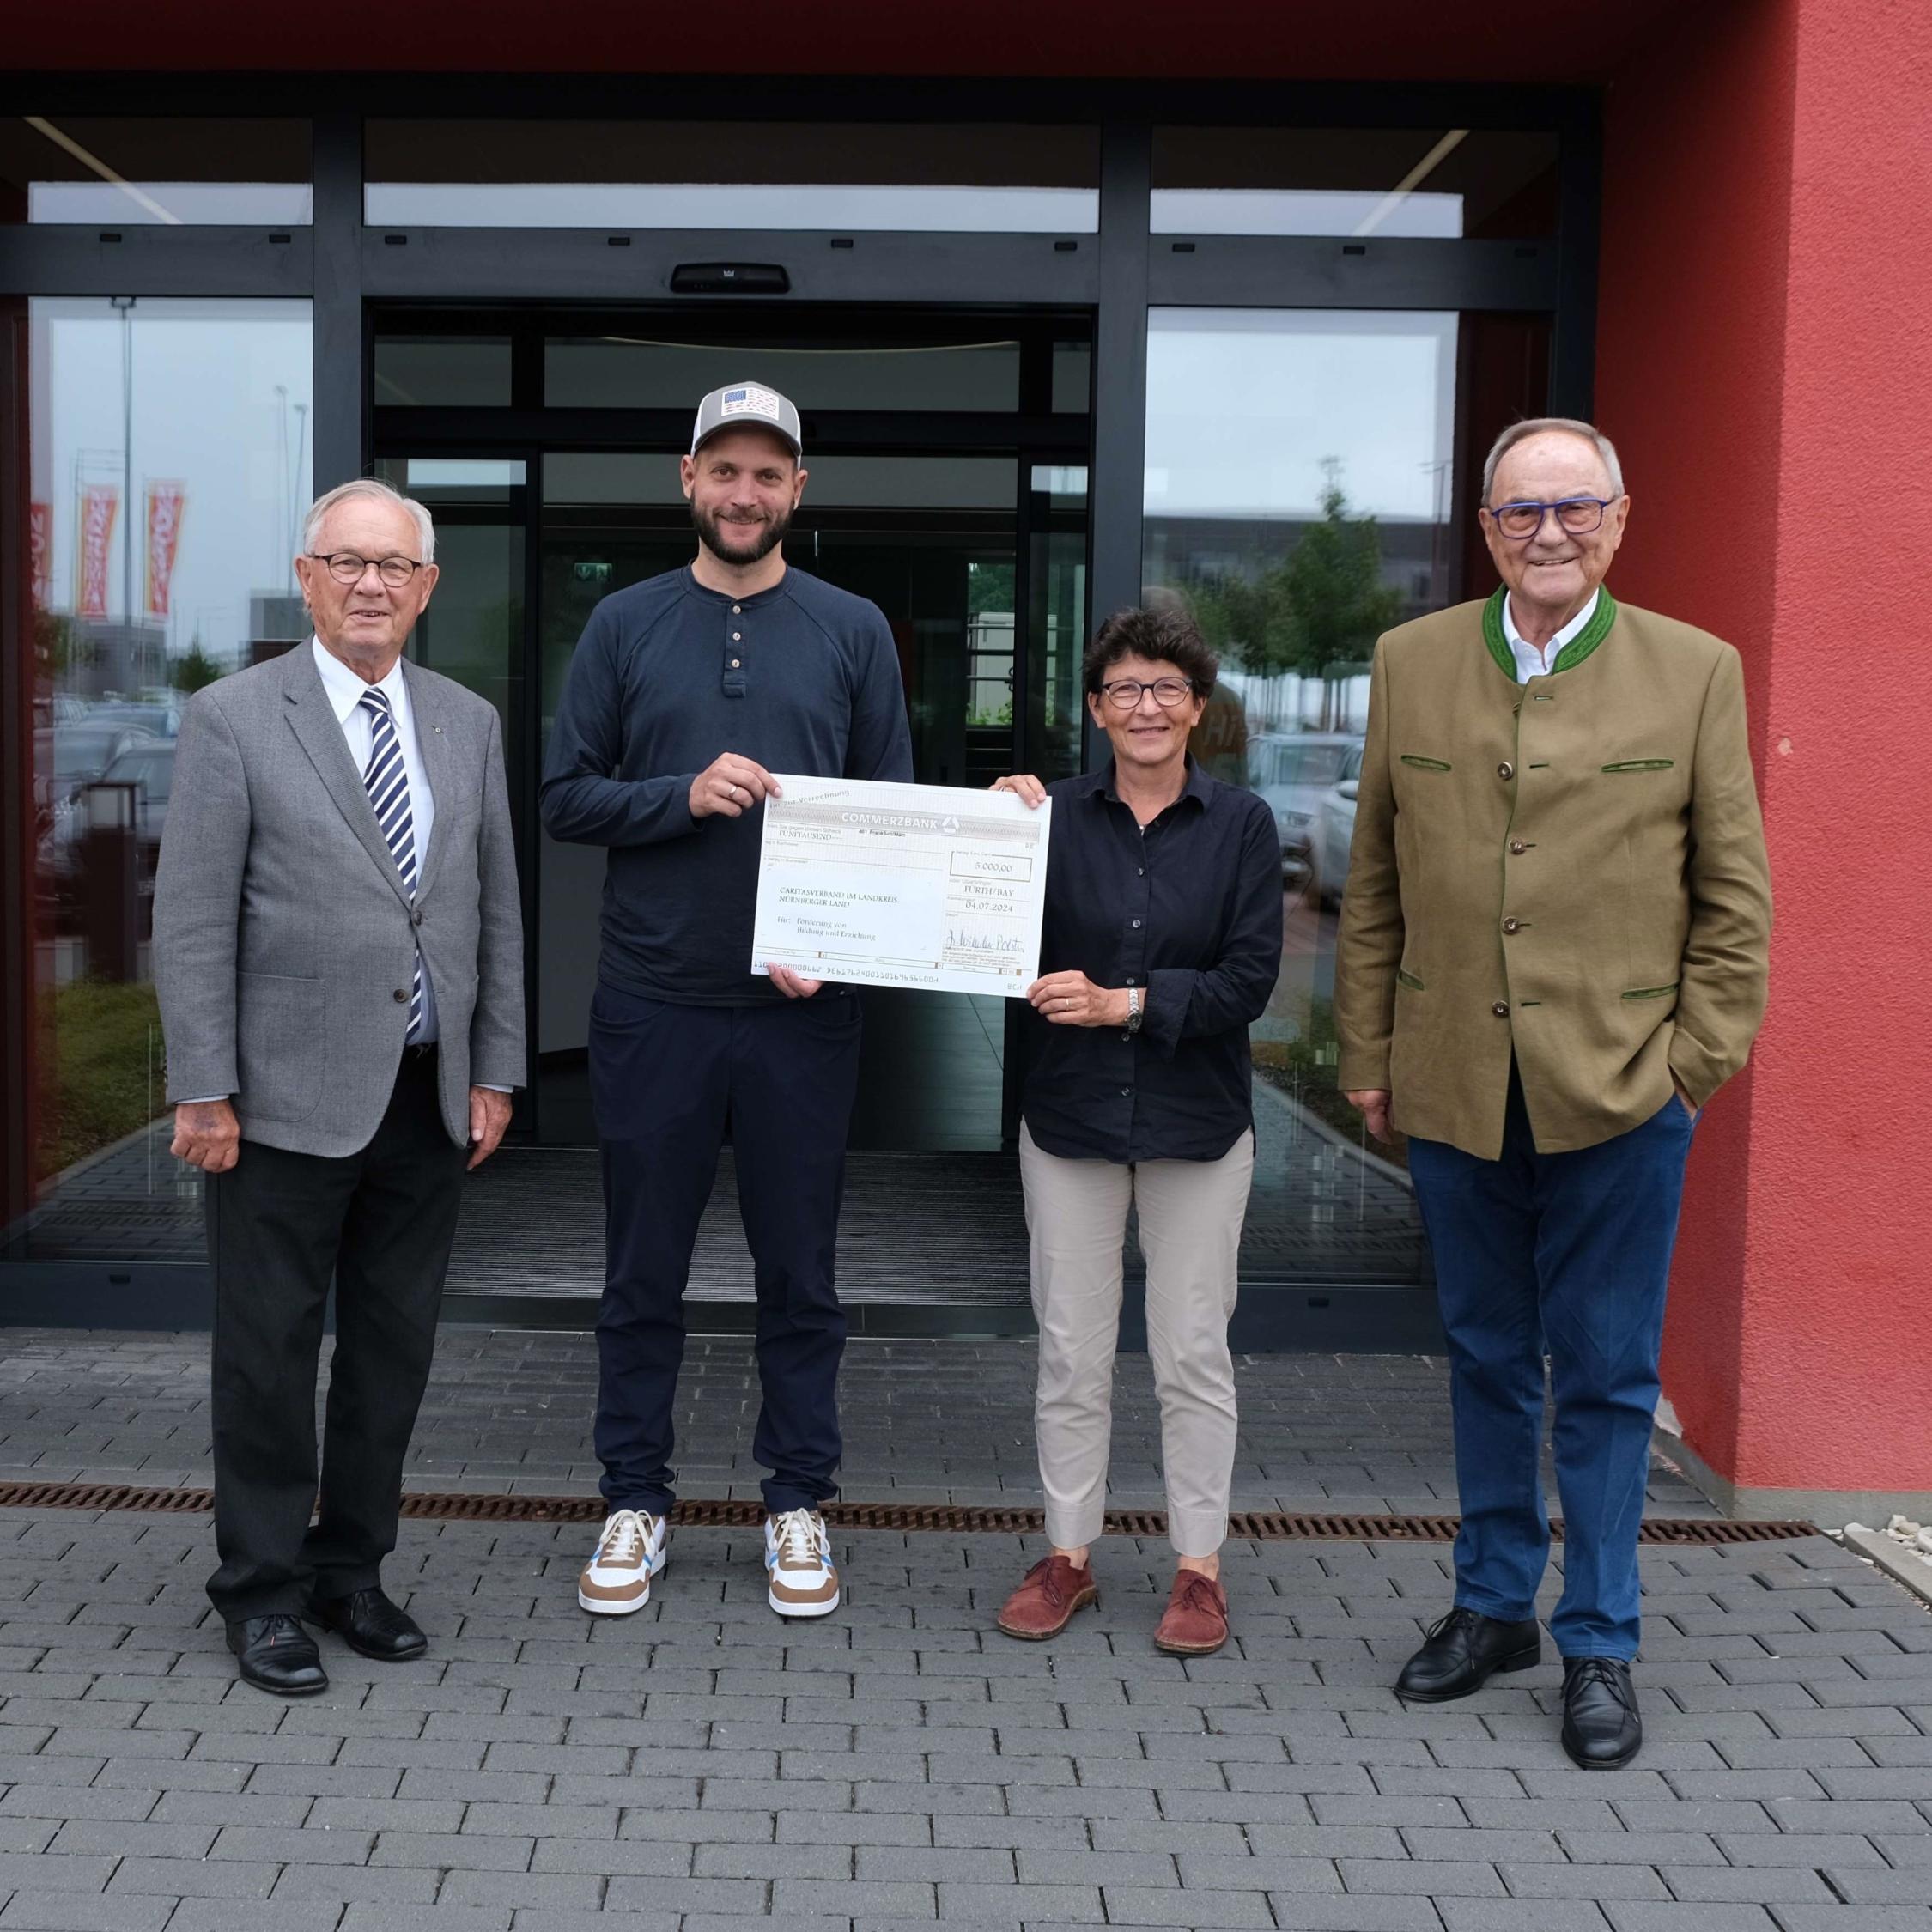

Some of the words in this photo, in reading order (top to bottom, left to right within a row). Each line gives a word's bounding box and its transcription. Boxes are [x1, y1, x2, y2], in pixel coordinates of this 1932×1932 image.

[841, 812, 938, 829] COMMERZBANK
[975, 861, 1012, 873] 5.000,00
[780, 887, 845, 900] CARITASVERBAND
[846, 892, 856, 901] IM
[858, 893, 898, 904] LANDKREIS
[829, 900, 850, 908] LAND
[965, 901, 1013, 913] 04.07.2024
[797, 927, 824, 937] Bildung
[825, 929, 840, 938] und
[841, 930, 876, 941] Erziehung
